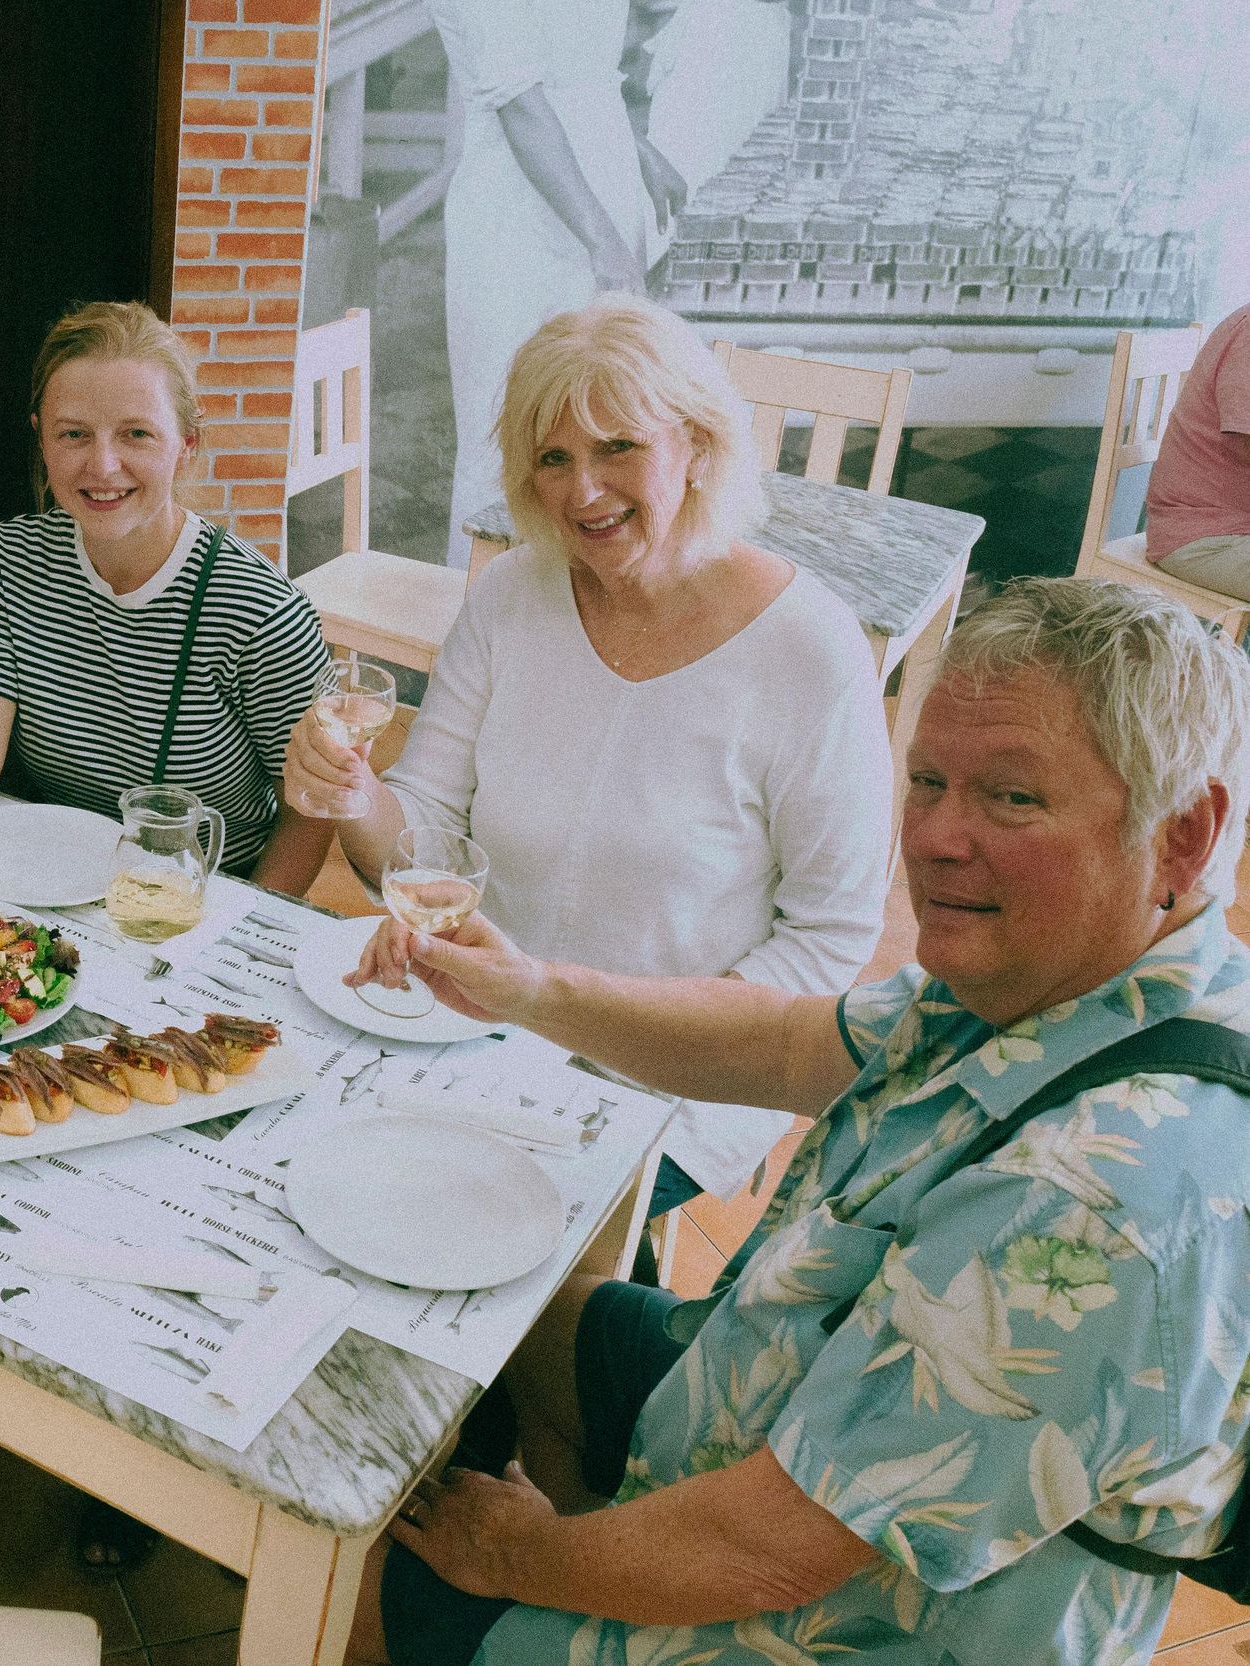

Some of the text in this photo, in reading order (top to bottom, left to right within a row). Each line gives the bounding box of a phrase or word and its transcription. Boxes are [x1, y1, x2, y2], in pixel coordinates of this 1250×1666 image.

[46, 1157, 83, 1177] SARDINE
[237, 1166, 262, 1182] CHUB
[14, 1198, 51, 1219] CODFISH
[202, 1215, 232, 1234] HORSE
[233, 1228, 281, 1255] MACKEREL
[196, 1335, 224, 1354] HAKE
